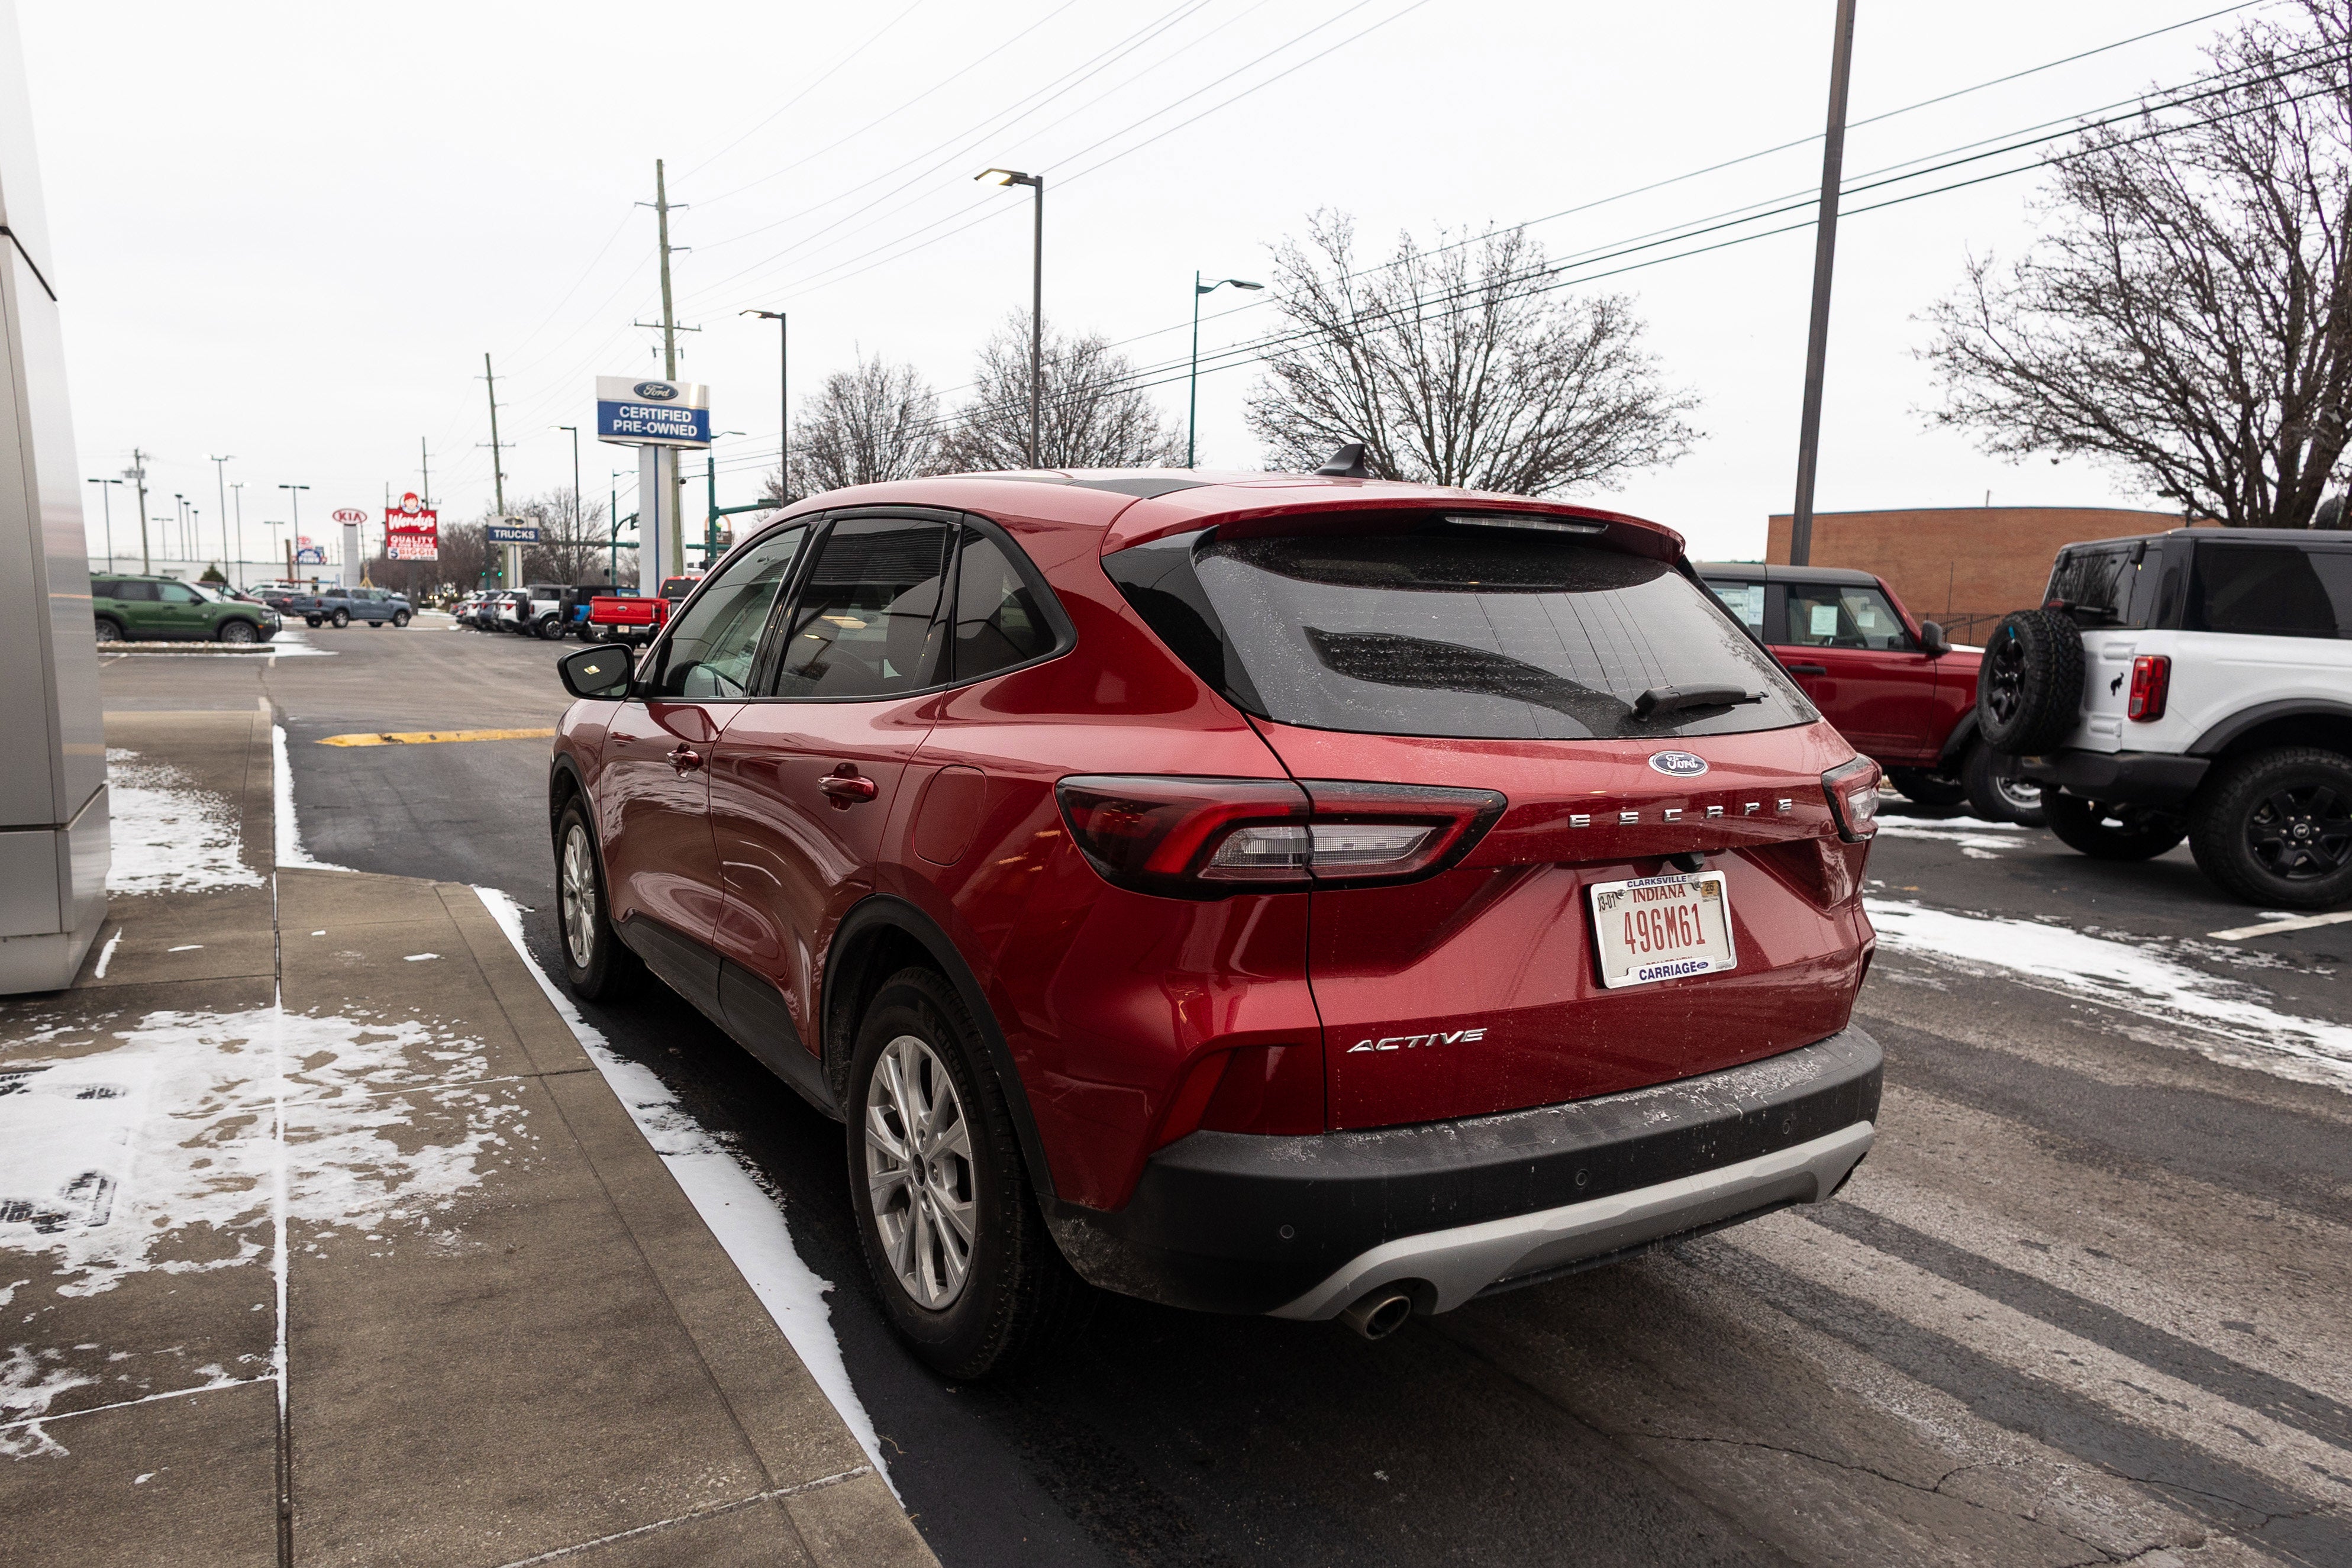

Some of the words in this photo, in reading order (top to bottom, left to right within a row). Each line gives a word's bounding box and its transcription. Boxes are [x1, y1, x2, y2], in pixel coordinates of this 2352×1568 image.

[643, 385, 670, 397] Ford
[620, 406, 692, 422] CERTIFIED
[613, 420, 698, 437] PRE-OWNED
[338, 512, 362, 521] KIA
[391, 535, 434, 544] QUALITY
[493, 529, 535, 539] TRUCKS
[1666, 754, 1698, 769] Ford
[1569, 798, 1792, 828] ESCAPE
[1627, 876, 1686, 888] CLARKSVILLE
[1705, 882, 1714, 891] 26
[1633, 884, 1686, 903] INDIANA
[1624, 904, 1705, 954] 496M61
[1639, 961, 1697, 980] CARRIAGE
[1346, 1028, 1488, 1053] ACTIVE
[937, 1027, 977, 1119] MICHELIN
